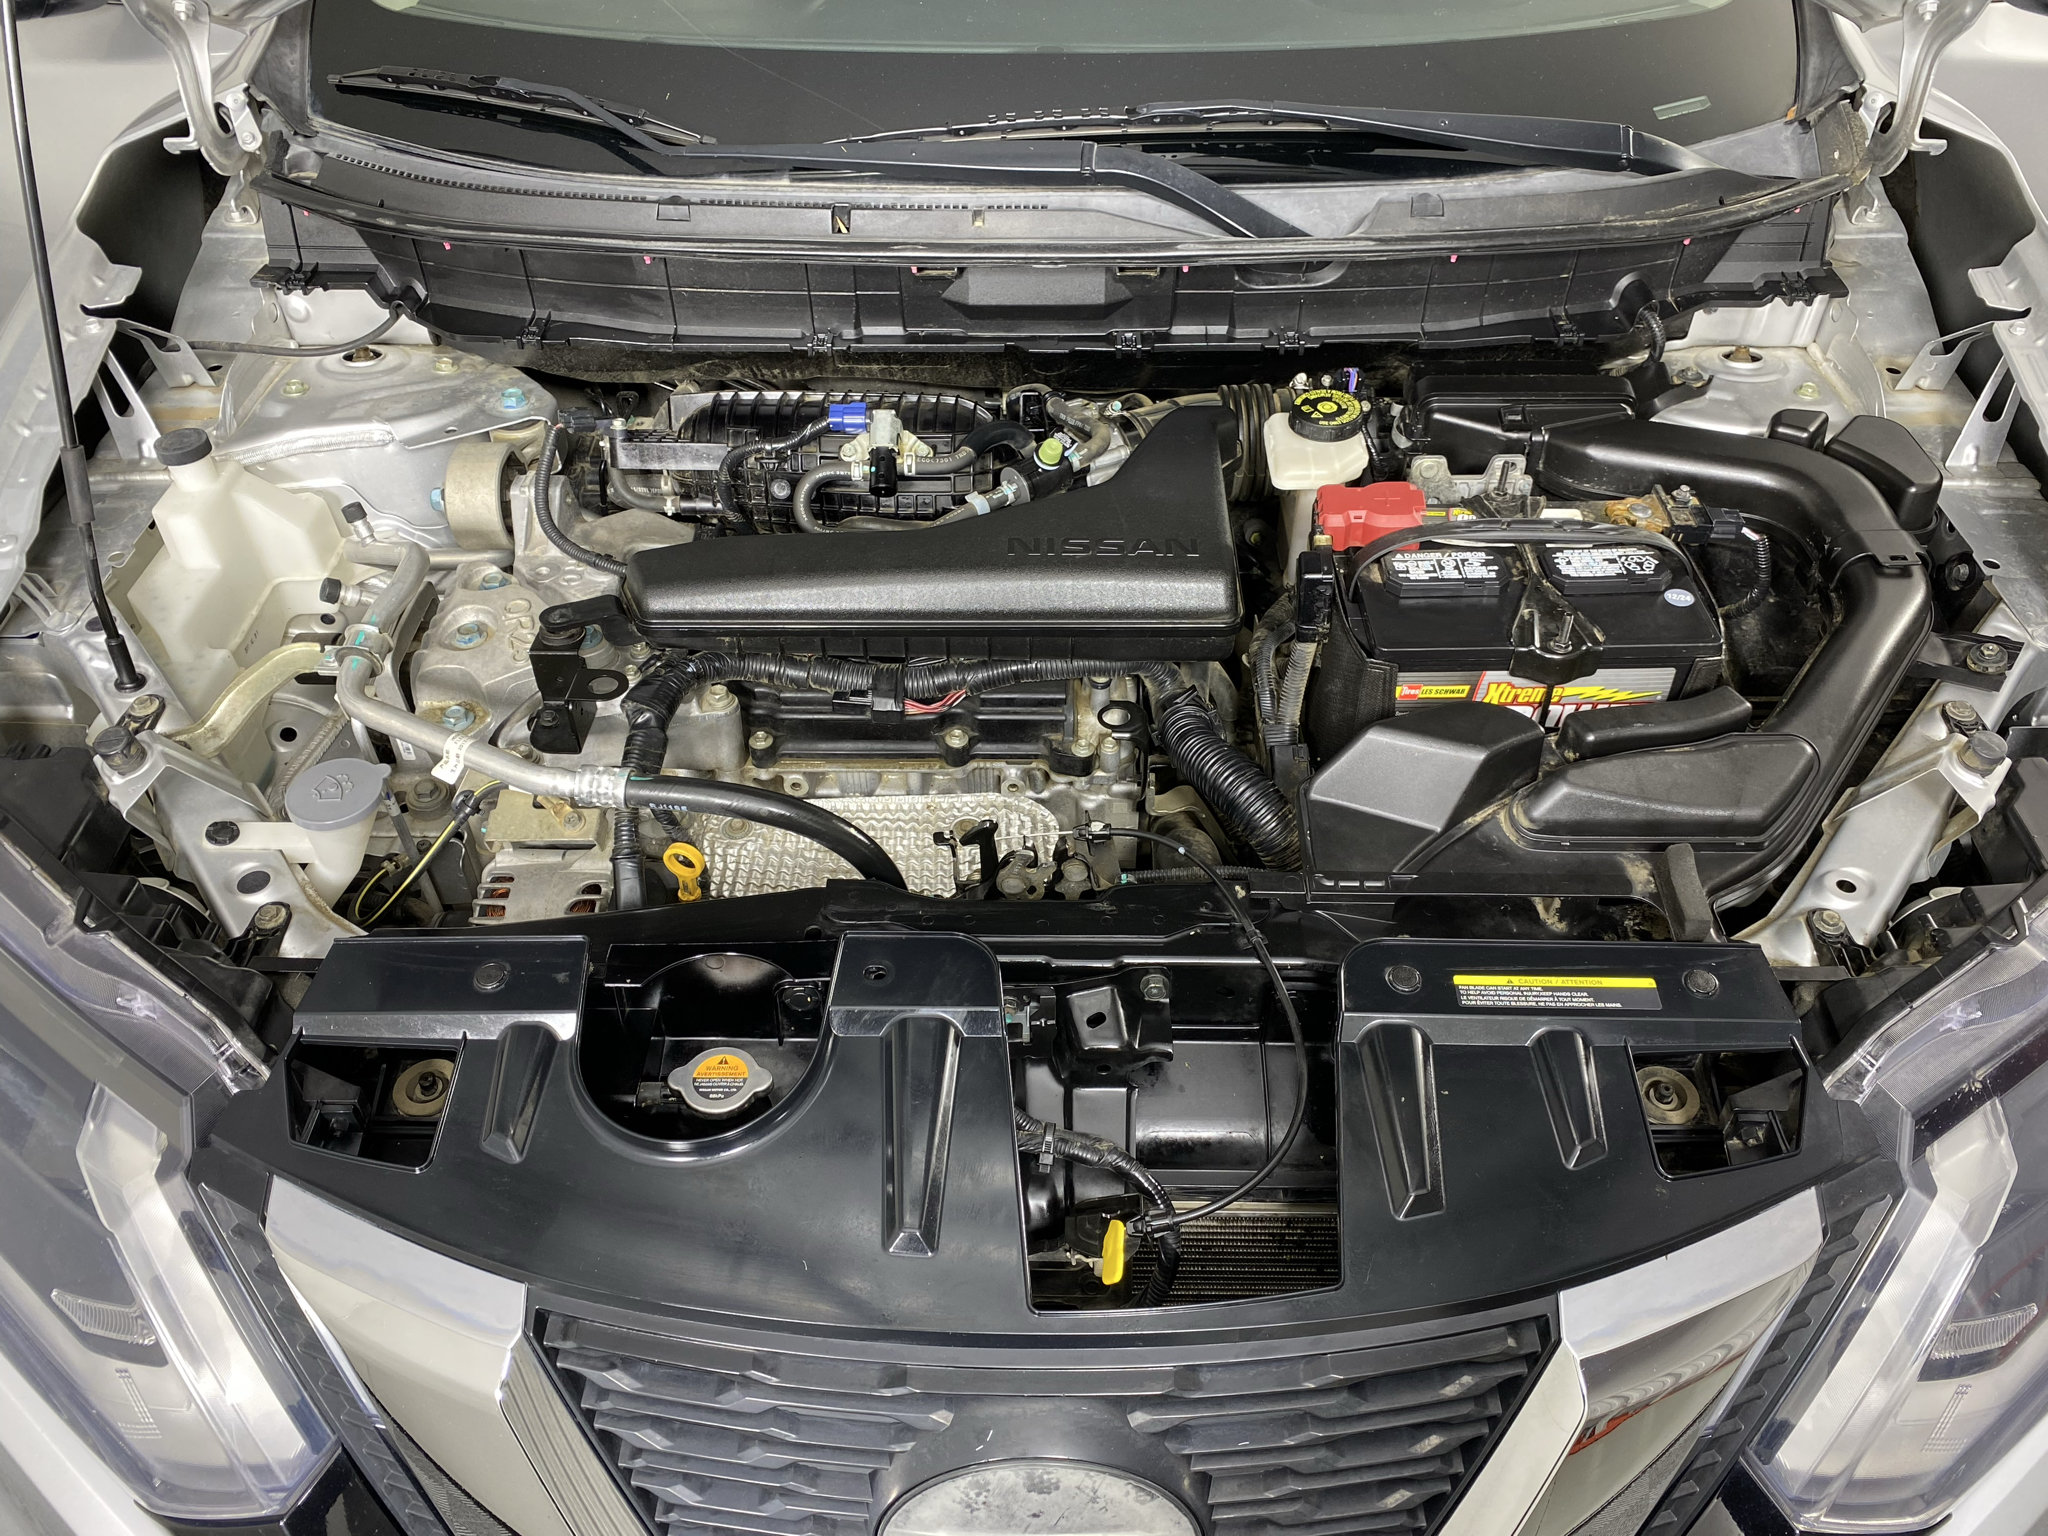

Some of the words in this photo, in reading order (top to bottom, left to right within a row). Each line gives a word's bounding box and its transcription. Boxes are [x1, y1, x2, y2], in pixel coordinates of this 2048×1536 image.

[1007, 537, 1200, 557] NISSAN
[1667, 593, 1691, 602] 12/24
[1401, 686, 1420, 696] Tires
